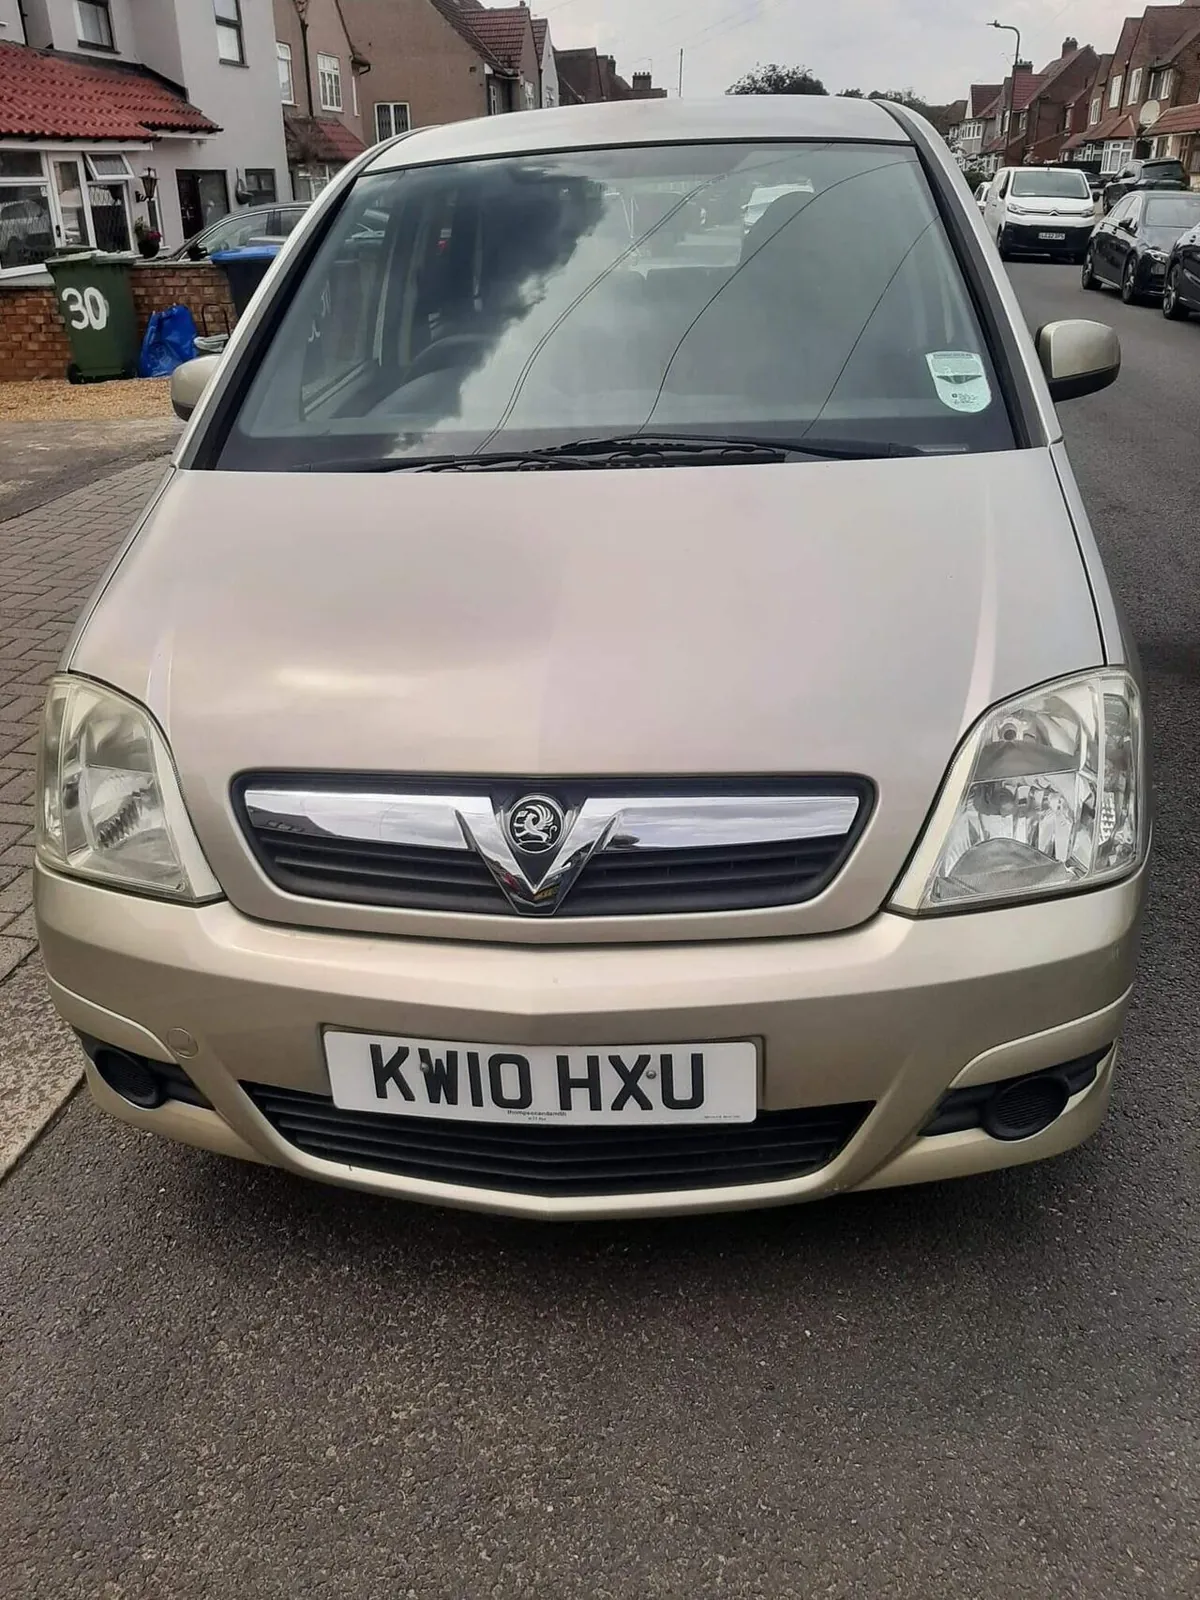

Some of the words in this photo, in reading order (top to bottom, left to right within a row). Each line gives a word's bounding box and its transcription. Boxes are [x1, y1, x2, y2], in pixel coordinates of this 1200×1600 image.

[61, 286, 109, 330] 30
[369, 1043, 533, 1110] KW10
[556, 1052, 705, 1112] HXU
